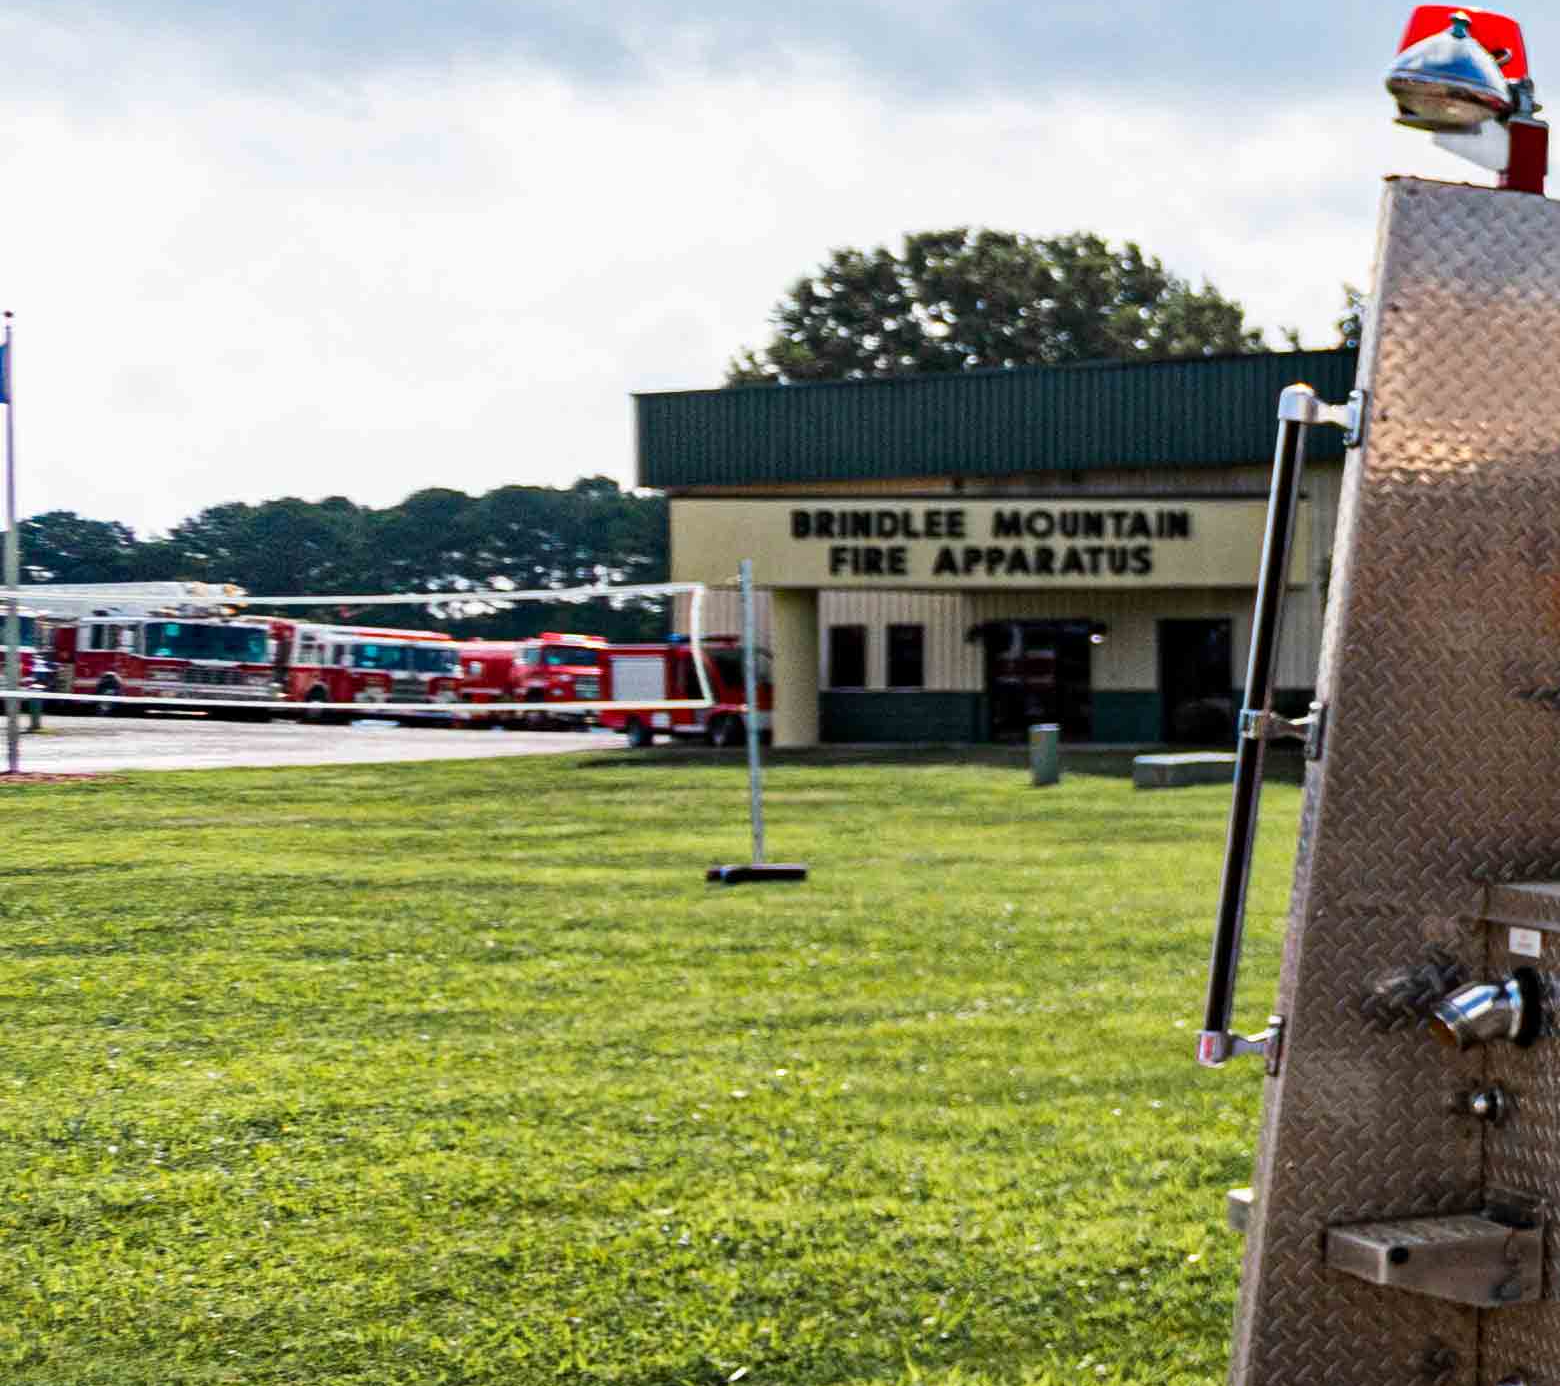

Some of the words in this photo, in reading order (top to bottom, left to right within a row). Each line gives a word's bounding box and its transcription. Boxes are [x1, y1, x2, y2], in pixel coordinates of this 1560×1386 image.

[790, 509, 967, 539] BRINDLEE
[991, 509, 1191, 539] MOUNTAIN
[828, 545, 908, 576] FIRE
[931, 545, 1154, 576] APPARATUS
